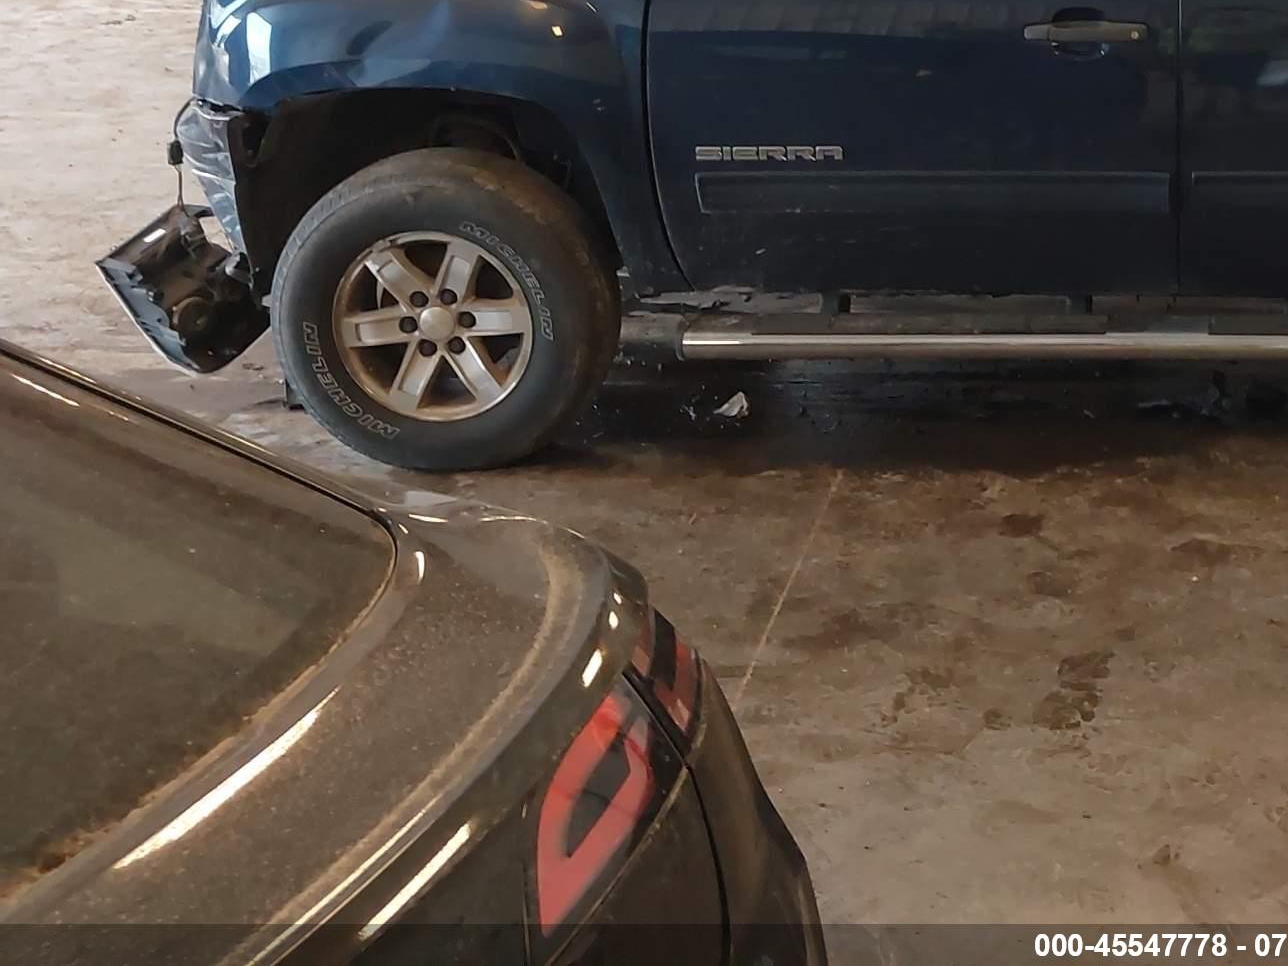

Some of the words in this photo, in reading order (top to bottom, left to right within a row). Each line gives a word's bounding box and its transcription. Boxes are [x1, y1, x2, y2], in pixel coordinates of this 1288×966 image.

[695, 146, 843, 161] SIERRA
[459, 220, 555, 342] MICHELIN
[302, 321, 401, 440] MICHELIN
